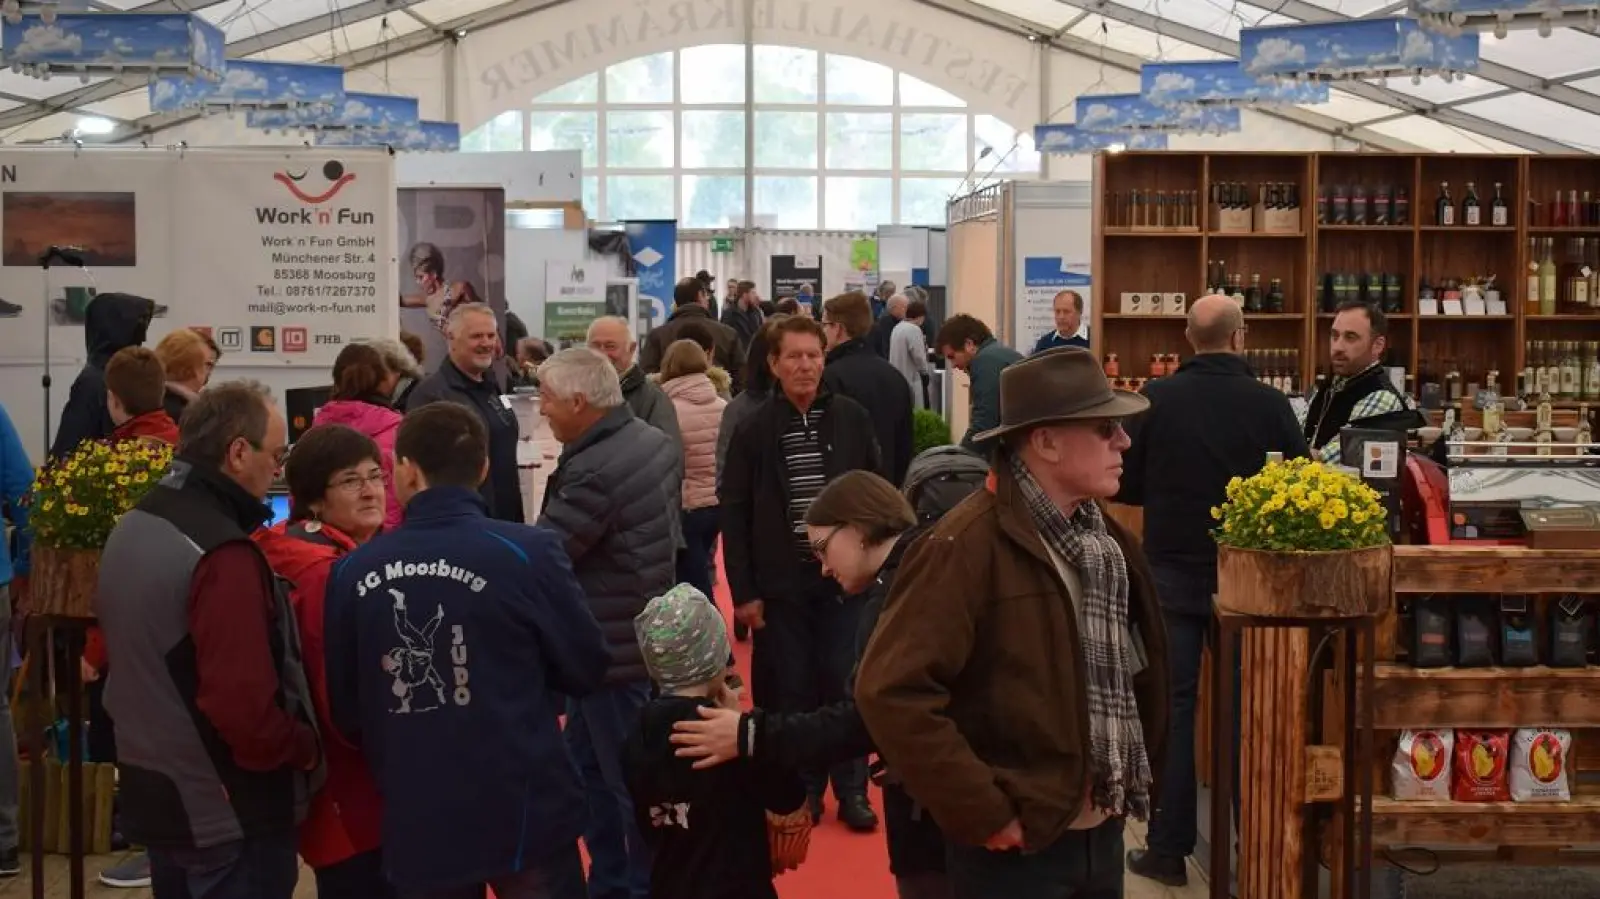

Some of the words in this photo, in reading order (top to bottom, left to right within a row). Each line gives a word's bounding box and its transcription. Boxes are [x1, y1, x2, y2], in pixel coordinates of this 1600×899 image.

[255, 207, 312, 224] Work
[338, 208, 374, 224] Fun
[336, 235, 376, 247] GmbH
[272, 251, 341, 264] Münchener
[344, 253, 364, 264] Str.
[367, 253, 376, 264] 4
[273, 268, 310, 281] 85368
[313, 268, 376, 283] Moosburg
[356, 570, 382, 598] SG
[384, 558, 488, 593] Moosburg
[450, 624, 472, 706] JUDO
